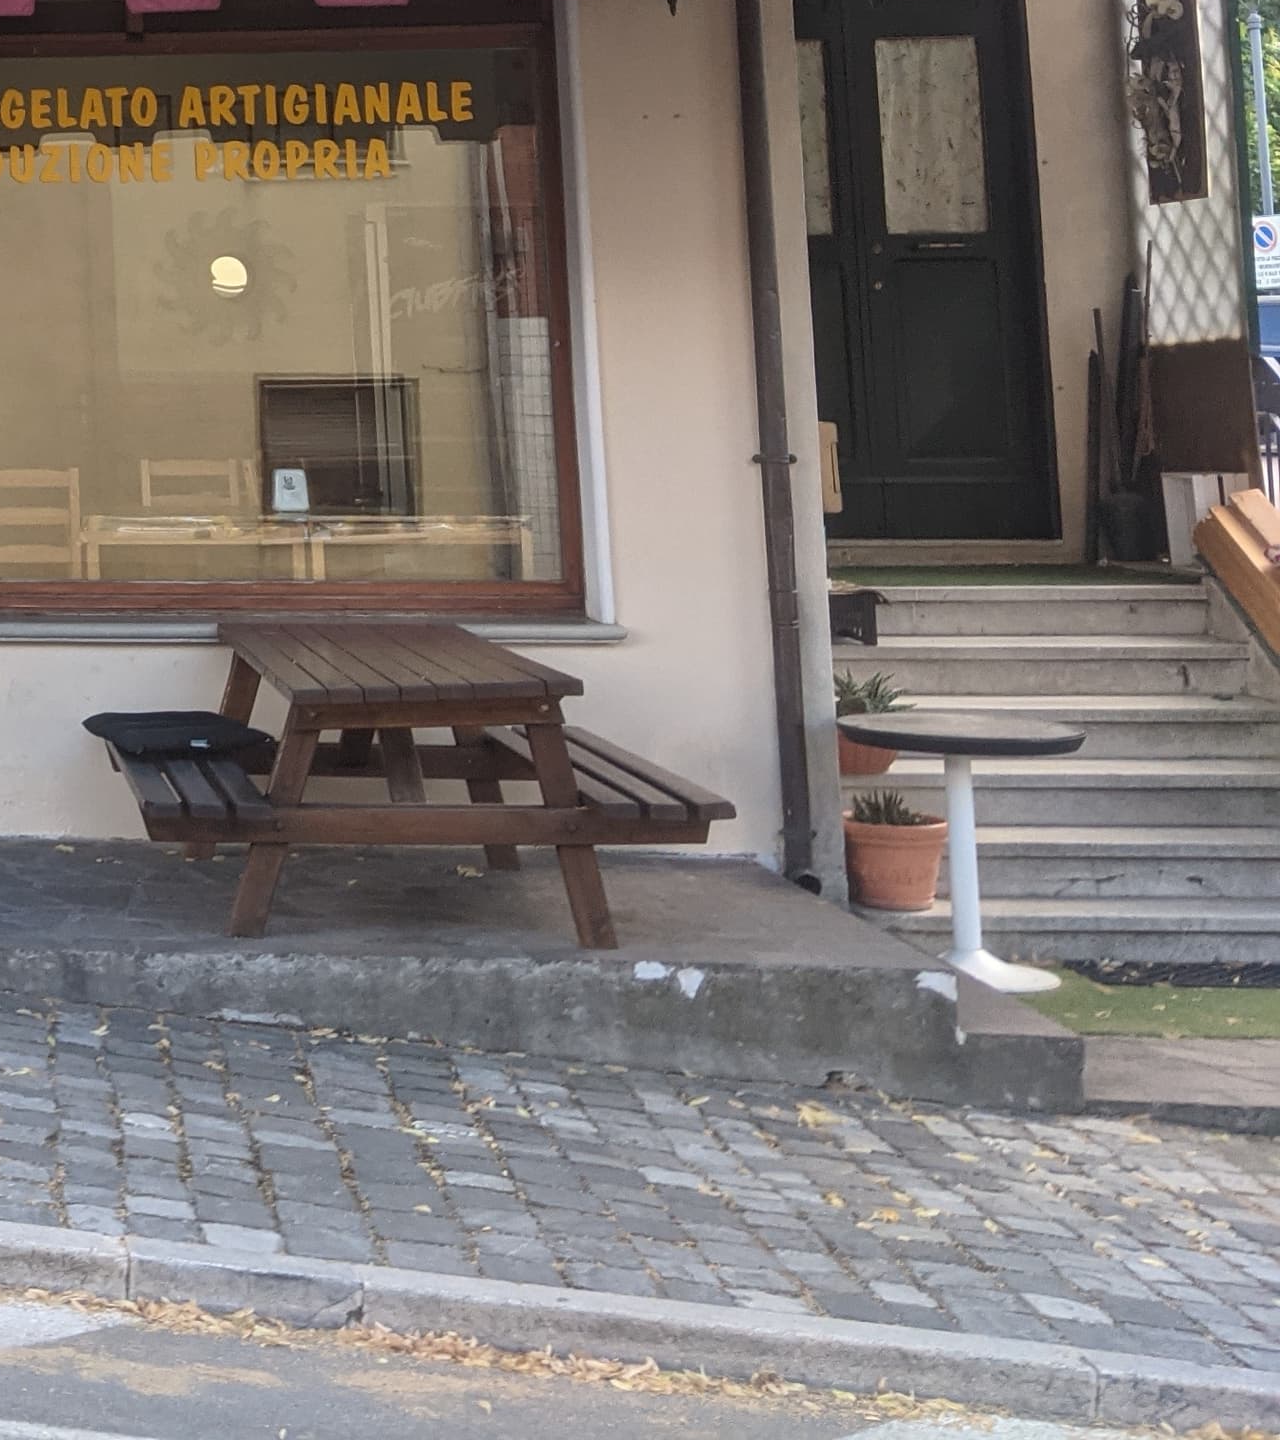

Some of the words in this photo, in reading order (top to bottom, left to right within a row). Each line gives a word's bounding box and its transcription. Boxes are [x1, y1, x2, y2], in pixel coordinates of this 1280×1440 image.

[0, 84, 159, 129] GELATO
[179, 80, 474, 128] ARTIGIANALE
[195, 137, 392, 180] PROPRIA
